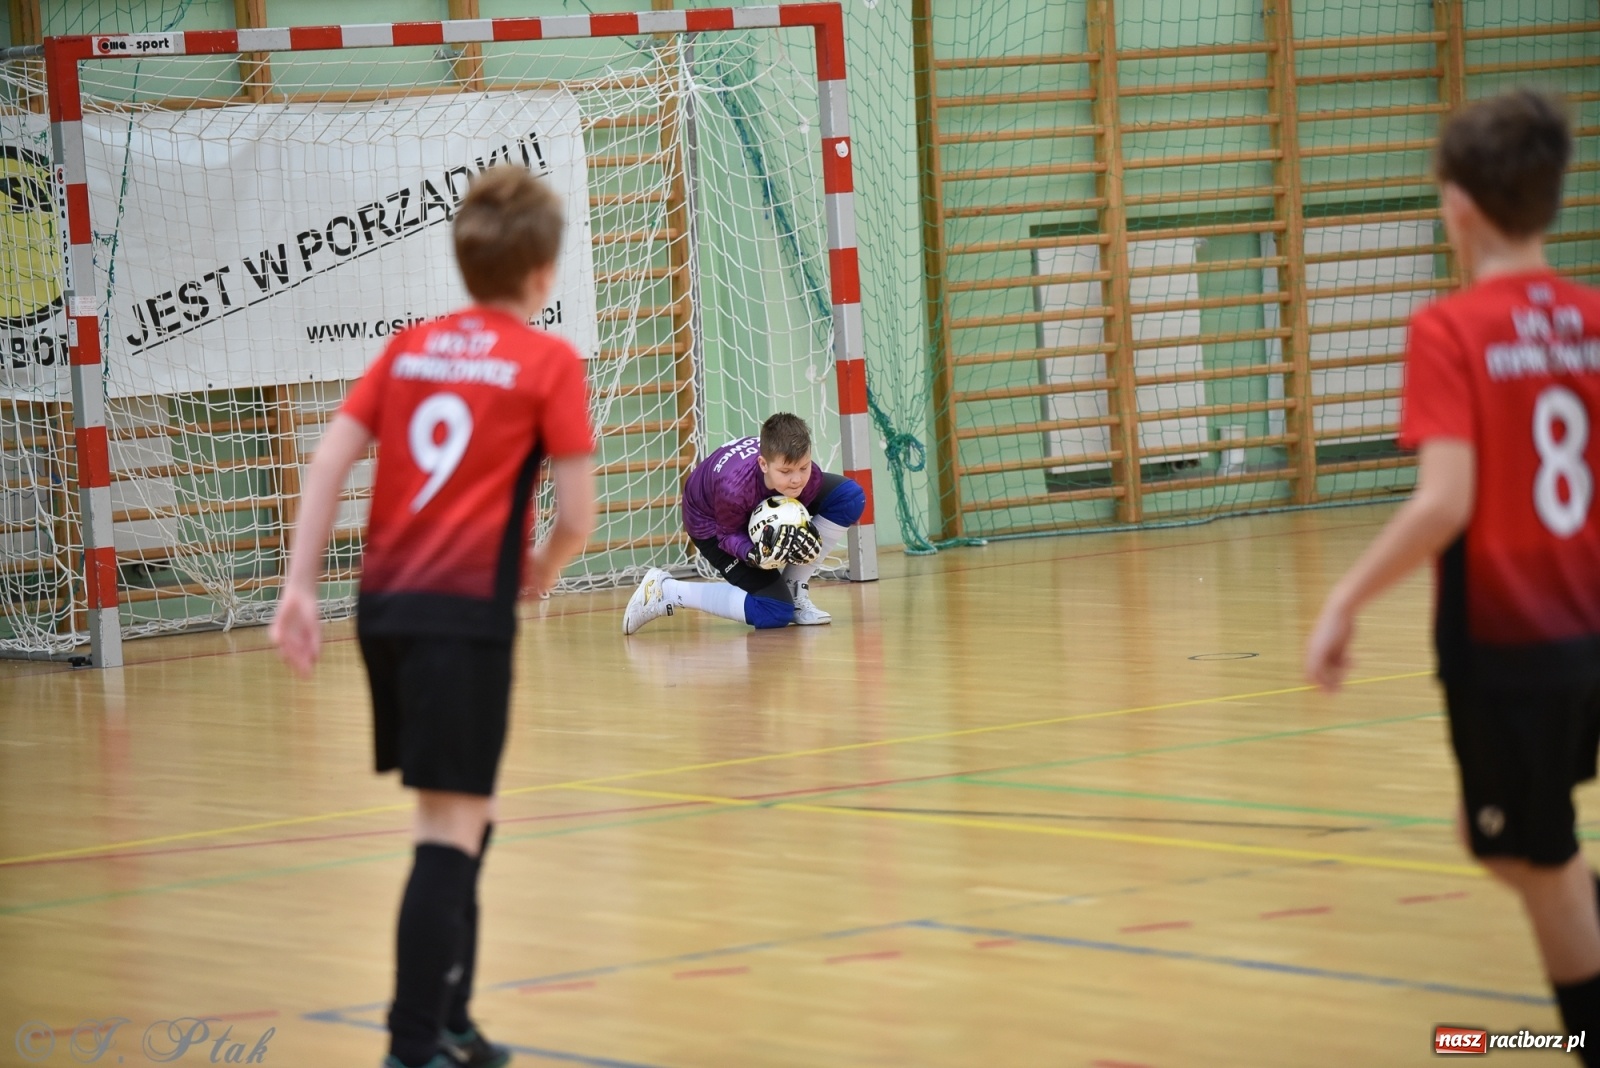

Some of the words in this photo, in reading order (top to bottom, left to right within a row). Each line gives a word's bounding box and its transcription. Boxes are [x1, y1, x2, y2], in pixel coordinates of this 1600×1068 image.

[136, 37, 170, 52] sport
[126, 265, 231, 346] JEST
[242, 243, 290, 293] W
[407, 391, 474, 515] 9
[1532, 385, 1595, 539] 8
